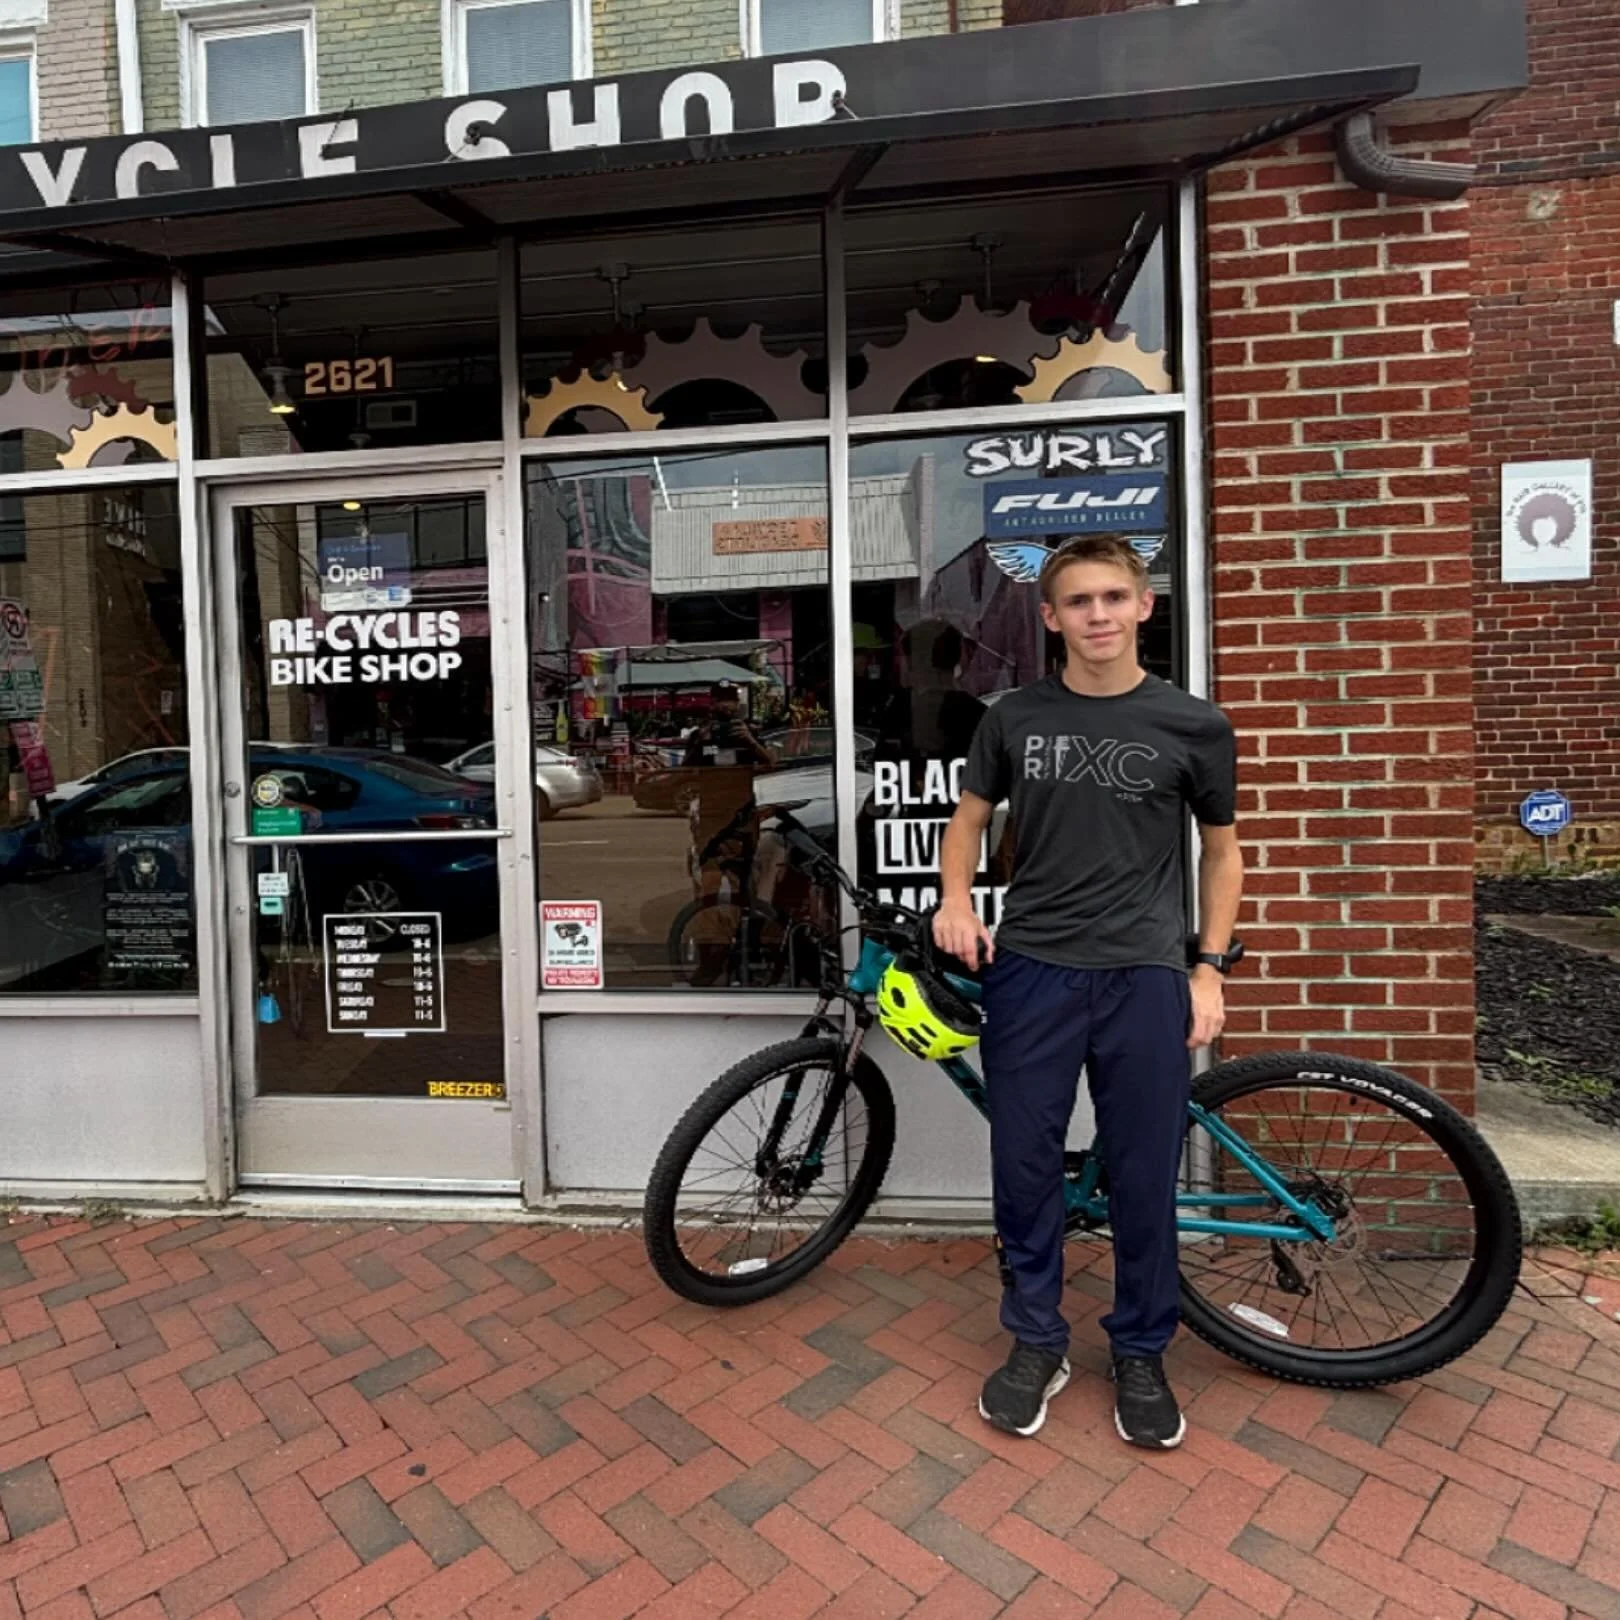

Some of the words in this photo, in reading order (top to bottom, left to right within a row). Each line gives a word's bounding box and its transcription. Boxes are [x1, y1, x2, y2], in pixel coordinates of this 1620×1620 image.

[445, 60, 847, 161] SHOP
[305, 356, 393, 394] 2621
[965, 430, 1167, 476] SURLY
[992, 487, 1161, 513] FUJI
[1096, 511, 1146, 522] DEALER
[327, 564, 384, 587] Open
[268, 610, 461, 654] RE-CYCLES
[271, 656, 353, 686] BIKE
[359, 651, 462, 683] SHOP
[874, 757, 968, 806] BLAC
[1527, 803, 1565, 821] ADT
[883, 821, 942, 868] LIV
[544, 907, 596, 919] WARNING
[427, 1081, 492, 1097] BREEZER
